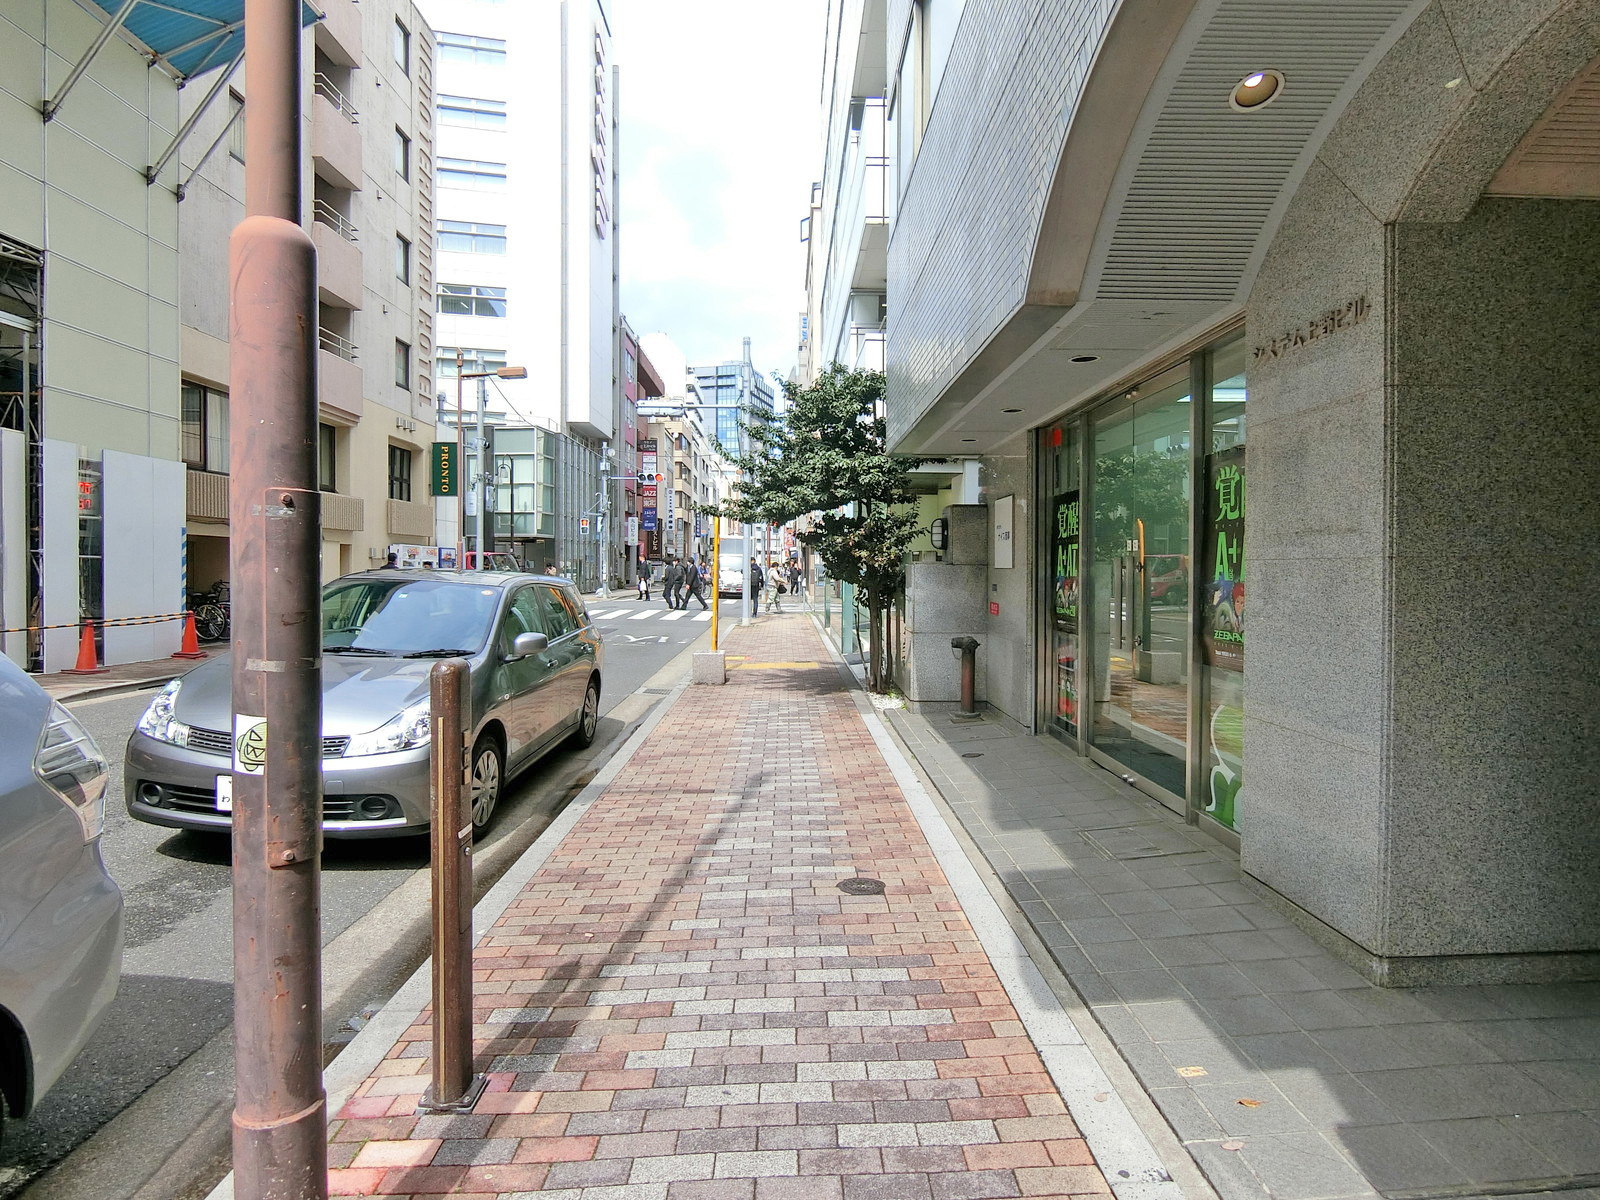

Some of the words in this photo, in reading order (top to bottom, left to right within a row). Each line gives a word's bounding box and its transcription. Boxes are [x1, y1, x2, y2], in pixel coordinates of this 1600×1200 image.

[418, 132, 432, 303] TERMINAL
[418, 307, 432, 408] HOTEL
[441, 446, 449, 493] PRONTO
[1215, 464, 1245, 522] 覚
